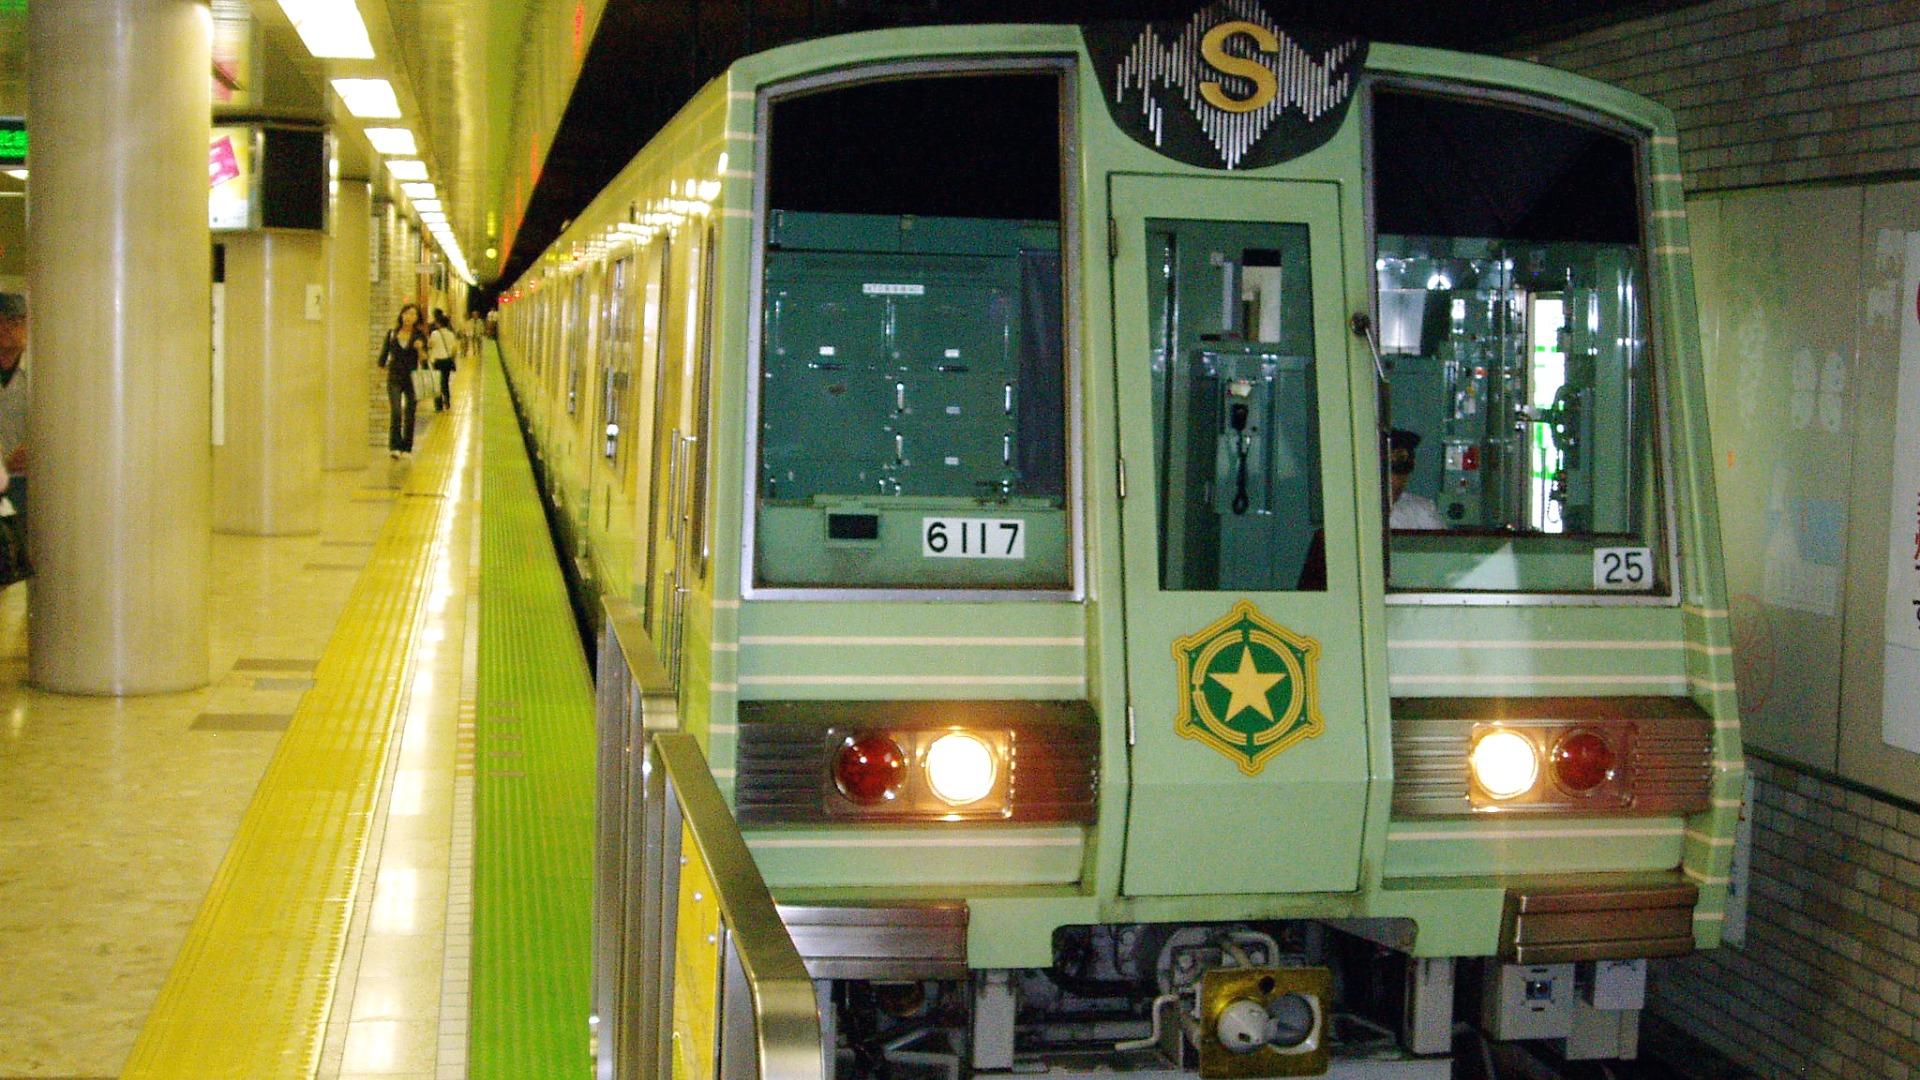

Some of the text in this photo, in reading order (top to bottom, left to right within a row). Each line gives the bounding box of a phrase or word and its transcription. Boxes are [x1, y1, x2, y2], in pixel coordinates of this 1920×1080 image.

[1200, 21, 1278, 112] S
[927, 521, 1019, 555] 6117
[1602, 552, 1643, 583] 25
